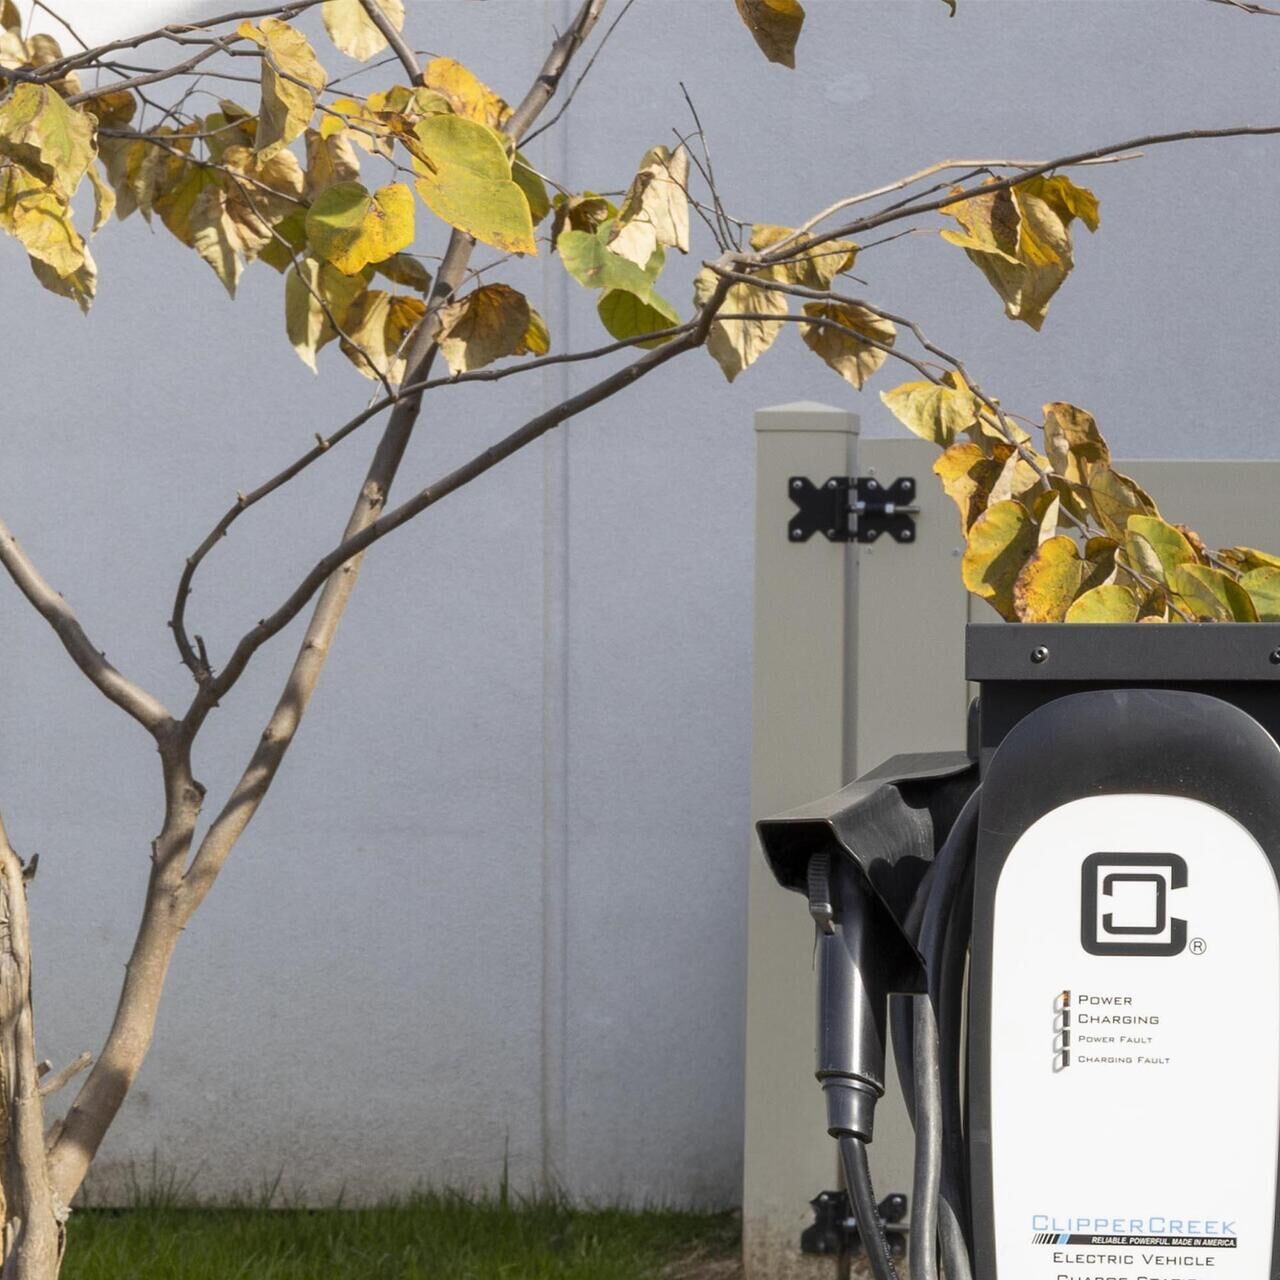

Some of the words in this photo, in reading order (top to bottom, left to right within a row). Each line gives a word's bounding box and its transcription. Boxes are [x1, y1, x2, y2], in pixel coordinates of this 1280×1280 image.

[1092, 1236, 1128, 1245] RELIABLE.
[1129, 1237, 1170, 1246] POWERFUL.
[1172, 1238, 1192, 1246] MADE
[1202, 1239, 1236, 1247] AMERICA.
